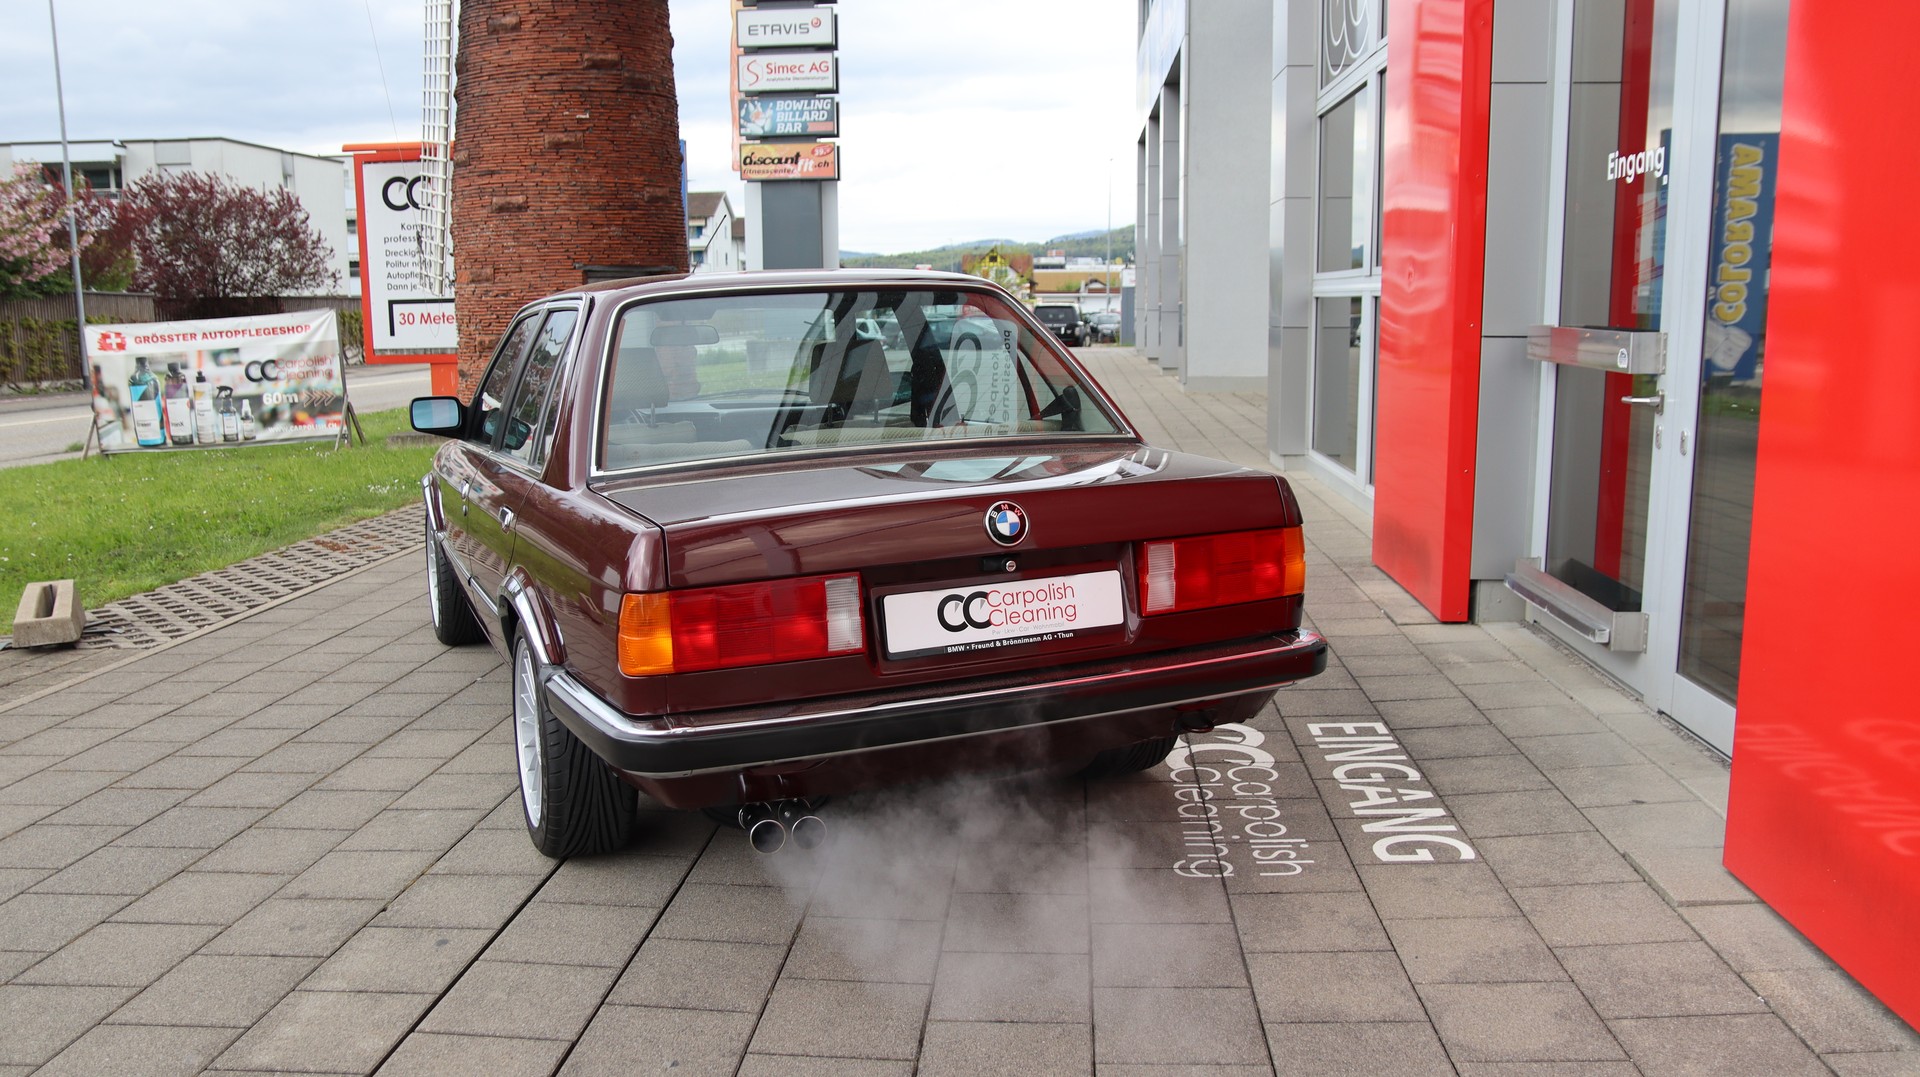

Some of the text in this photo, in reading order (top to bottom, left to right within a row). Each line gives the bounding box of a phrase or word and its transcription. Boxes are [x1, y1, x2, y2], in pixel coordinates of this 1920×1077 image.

[748, 23, 810, 36] ETAVIS
[766, 60, 830, 75] Simec AG
[776, 99, 832, 111] BOWLING
[776, 110, 828, 122] BILLARD
[776, 122, 803, 133] BAR
[1607, 145, 1665, 184] Eingang
[386, 260, 410, 268] Politur
[387, 283, 409, 291] Dann
[399, 312, 455, 326] 30 Mete
[134, 324, 311, 345] GRÖSSTER AUTOPFLEGESHOP
[275, 355, 332, 370] Carpolish
[276, 366, 333, 381] Cleaning
[262, 392, 299, 405] 60m
[990, 504, 1022, 518] BMW
[986, 582, 1075, 608] Carpolish
[988, 603, 1077, 627] Cleaning
[947, 645, 965, 653] BMW
[971, 642, 994, 650] Freund
[1002, 636, 1042, 646] Brönnimann
[1042, 633, 1053, 641] AG
[1057, 631, 1074, 639] Thun
[1306, 722, 1476, 862] EINGANG
[1169, 766, 1240, 878] Cleaning
[1224, 765, 1315, 877] Carpolish
